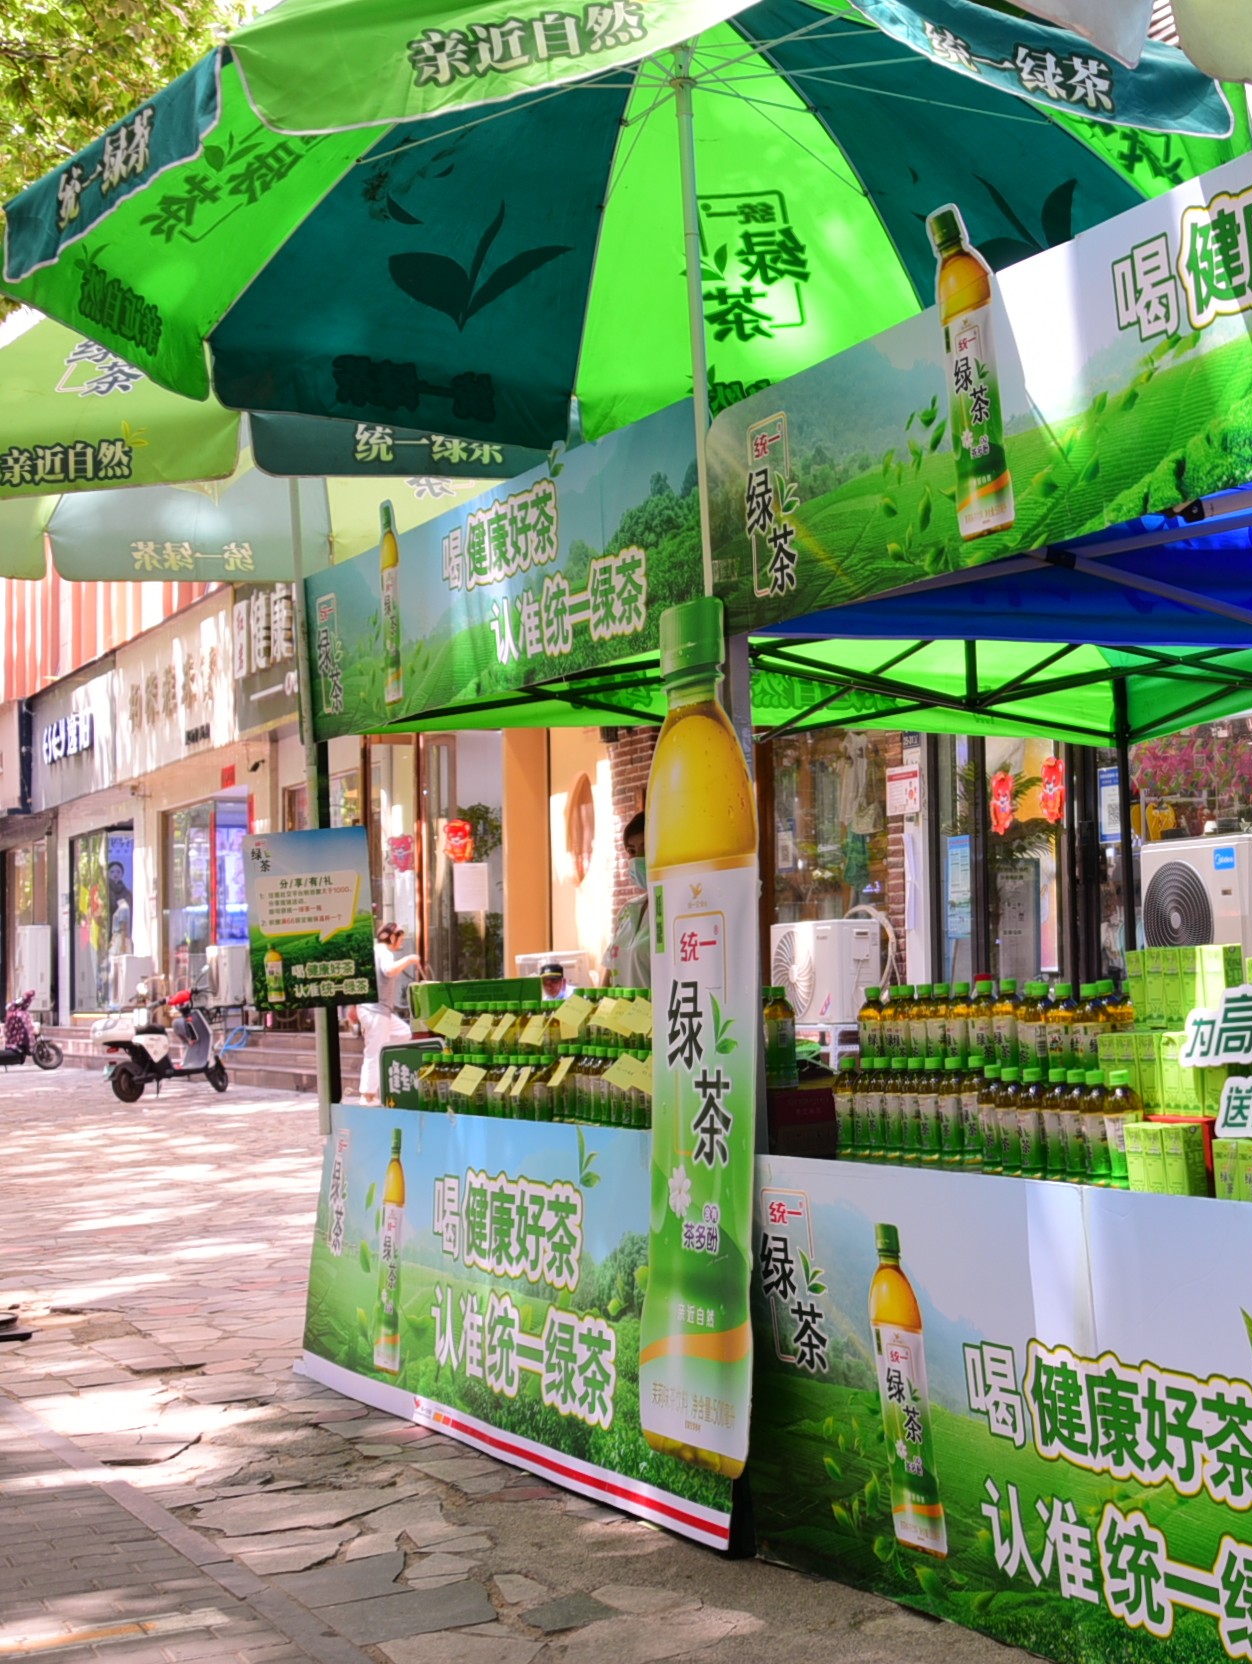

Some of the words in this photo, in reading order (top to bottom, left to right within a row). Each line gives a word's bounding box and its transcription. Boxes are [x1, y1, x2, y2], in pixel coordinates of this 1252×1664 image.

[410, 4, 645, 86] 亲近自然
[923, 22, 1115, 110] 统一绿茶
[954, 357, 990, 424] 绿茶
[0, 440, 132, 486] 亲近自然
[754, 432, 781, 459] 统一
[442, 484, 556, 590] 喝健康好茶
[746, 468, 798, 595] 绿茶
[491, 549, 645, 665] 认准统一绿茶
[680, 930, 717, 962] 统一
[667, 978, 732, 1167] 绿茶
[330, 1160, 345, 1257] 绿茶
[433, 1171, 581, 1289] 喝健康好茶
[682, 1223, 718, 1255] 茶多酚
[769, 1201, 802, 1224] 统一
[677, 1303, 716, 1328] 亲近自然
[760, 1232, 827, 1371] 绿茶
[431, 1283, 615, 1428] 认准统一绿茶
[886, 1367, 923, 1443] 绿茶
